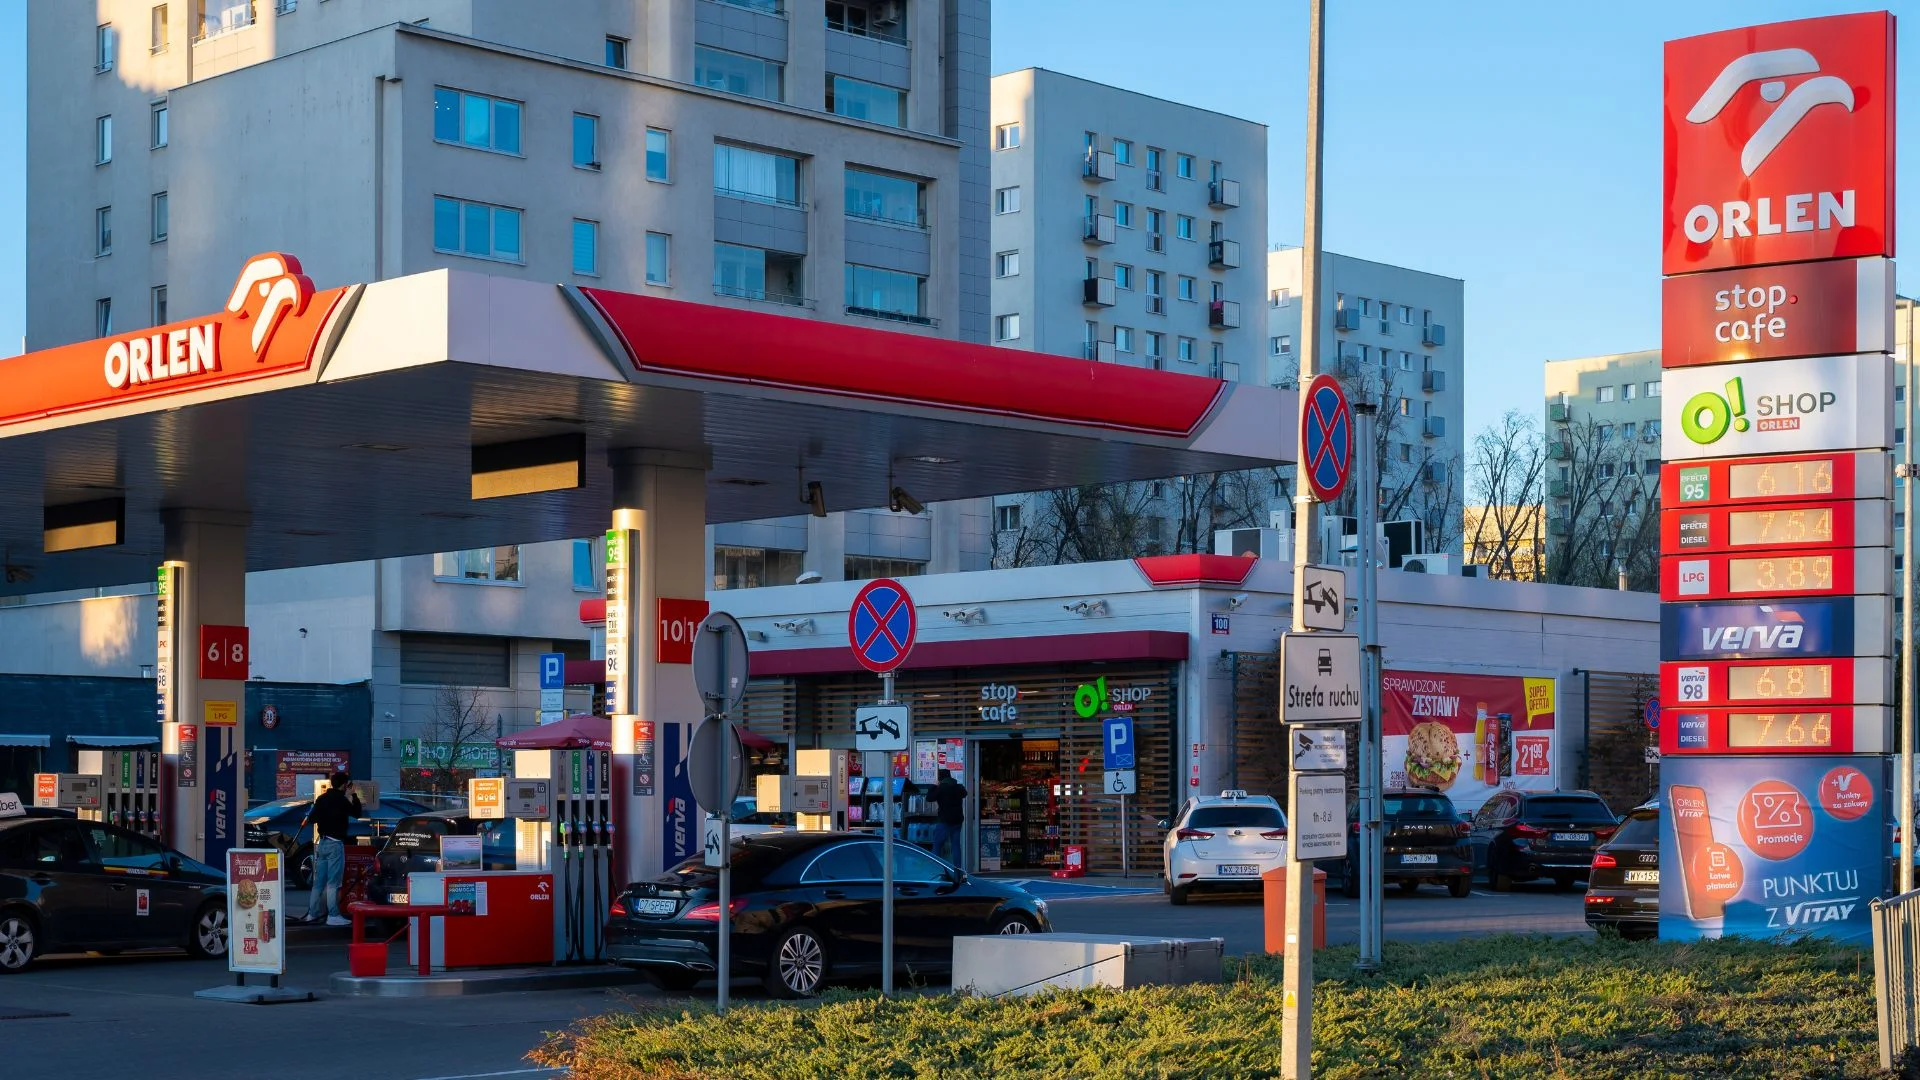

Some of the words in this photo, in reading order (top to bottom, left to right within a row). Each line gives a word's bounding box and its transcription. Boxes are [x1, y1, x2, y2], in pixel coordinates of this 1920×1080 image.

[1684, 190, 1855, 243] ORLEN
[1715, 284, 1787, 314] stop
[1715, 313, 1786, 343] cafe
[104, 322, 218, 389] ORLEN
[1757, 392, 1836, 417] SHOP
[1759, 418, 1798, 430] ORLEN
[1684, 484, 1705, 500] 95
[1758, 508, 1830, 543] 7.54
[1681, 536, 1707, 544] DIESEL
[1682, 572, 1705, 583] LPG
[1757, 557, 1831, 589] 3.89
[661, 619, 683, 642] 10
[1215, 618, 1228, 630] 100
[1702, 624, 1804, 651] verva
[208, 642, 220, 662] 6
[231, 643, 244, 663] 8
[545, 657, 559, 684] P
[1681, 674, 1706, 683] verva
[1383, 677, 1447, 695] SPRAWDZONE
[1756, 666, 1830, 697] 6.81
[981, 683, 1017, 705] stop
[1112, 687, 1151, 702] SHOP
[1288, 684, 1324, 709] Strefa
[1329, 684, 1359, 707] ruchu
[1529, 685, 1547, 698] SUPER
[1683, 685, 1704, 700] 98
[1113, 703, 1134, 712] ORLEN
[1412, 694, 1460, 718] ZESTAWY
[1530, 697, 1550, 711] OFERTA
[214, 712, 228, 720] LPG
[981, 702, 1017, 723] cafe
[1681, 721, 1706, 729] verva
[1757, 714, 1831, 745] 7.66
[1110, 723, 1127, 754] P
[1680, 735, 1706, 743] DIESEL
[1224, 790, 1245, 799] TAXI
[1836, 792, 1861, 800] Punkty
[1676, 798, 1705, 808] ORLEN
[1843, 800, 1868, 809] zakupy
[215, 788, 227, 840] verva
[1678, 809, 1704, 818] VITAY
[674, 796, 687, 858] verva
[1757, 832, 1803, 845] Promocje
[1631, 871, 1641, 881] WY
[1709, 872, 1731, 880] Łatwe
[1763, 869, 1859, 899] PUNKTUJ
[1706, 880, 1738, 892] płatności
[651, 900, 675, 912] SPEED
[1785, 899, 1858, 926] VITAY
